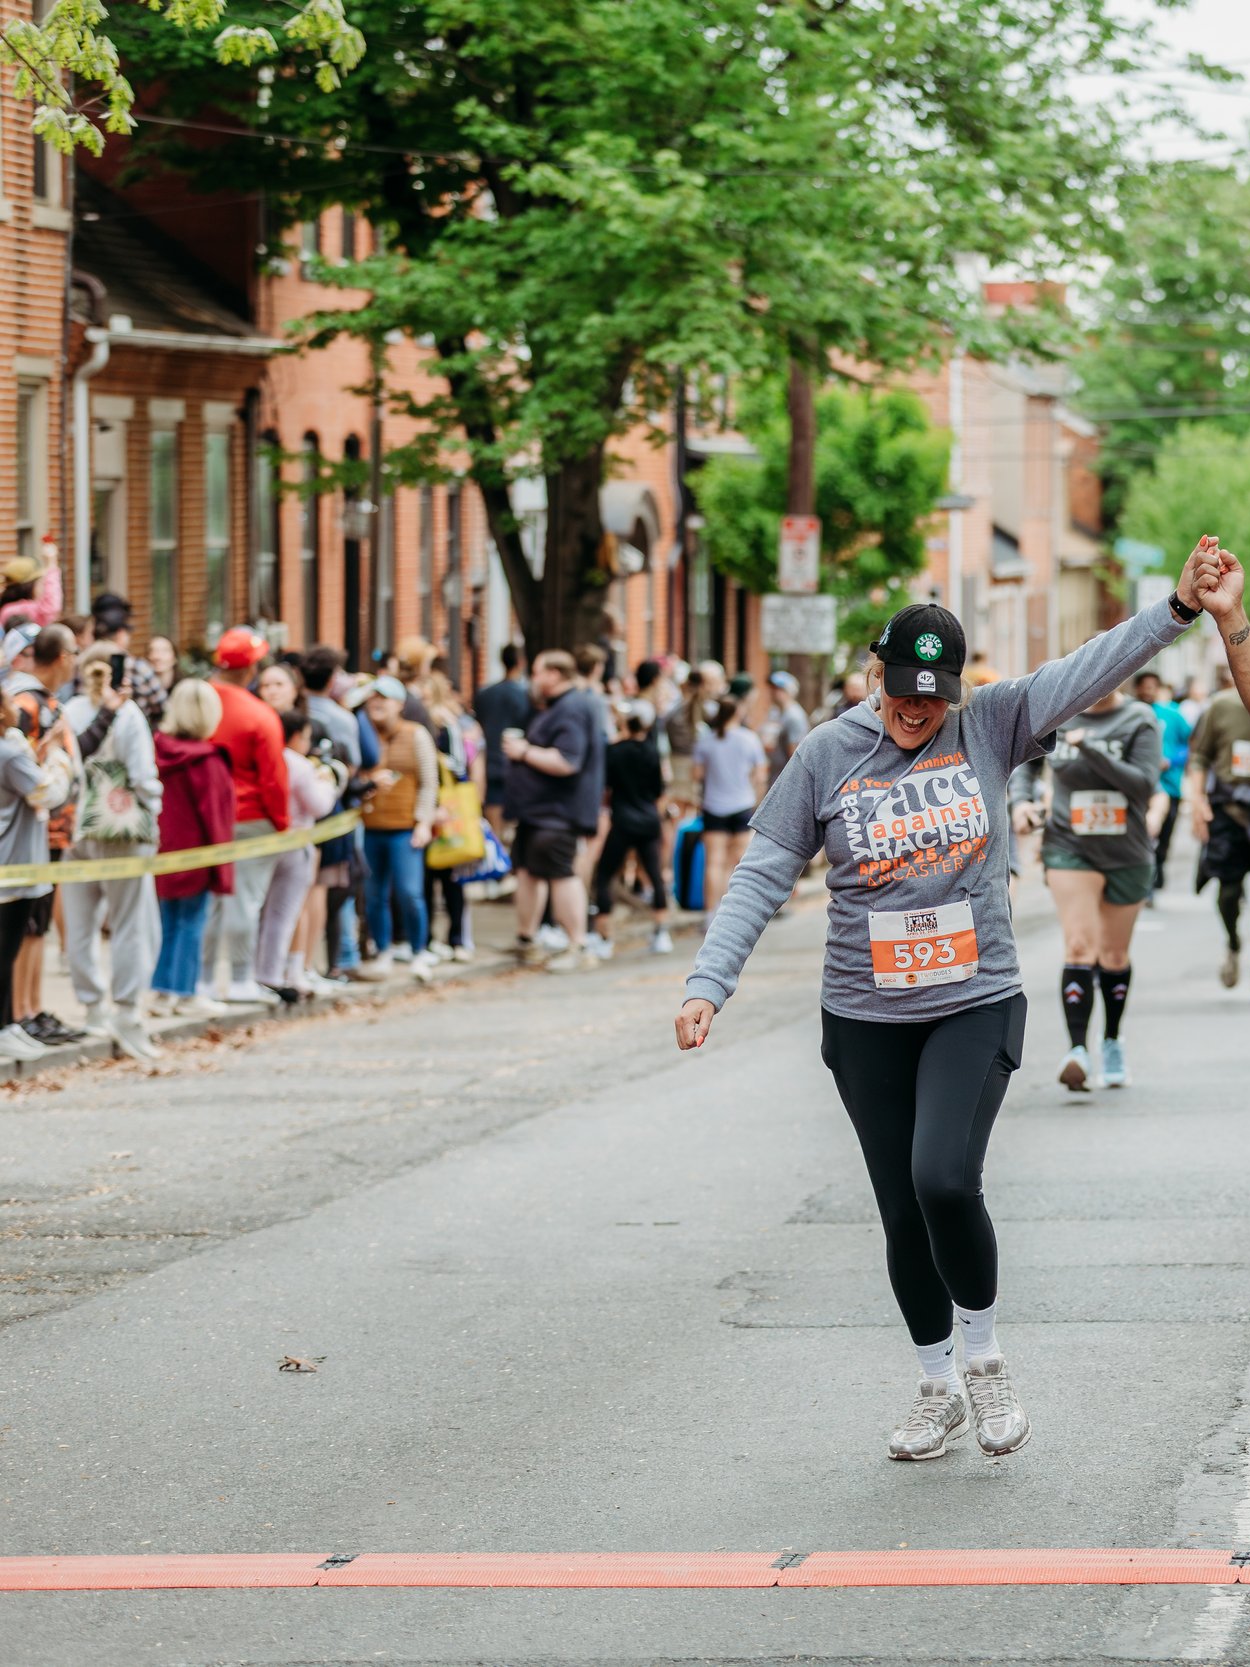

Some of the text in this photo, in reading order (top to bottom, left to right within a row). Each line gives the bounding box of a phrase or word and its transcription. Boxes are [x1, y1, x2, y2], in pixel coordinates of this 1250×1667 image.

[917, 633, 943, 648] CELTICS
[863, 777, 899, 789] Yea
[912, 751, 965, 772] unning!
[841, 793, 873, 861] ywca
[868, 813, 990, 861] RACISM
[873, 797, 983, 841] against
[859, 857, 909, 876] APRIL
[912, 847, 943, 864] 25,
[894, 937, 956, 969] 593
